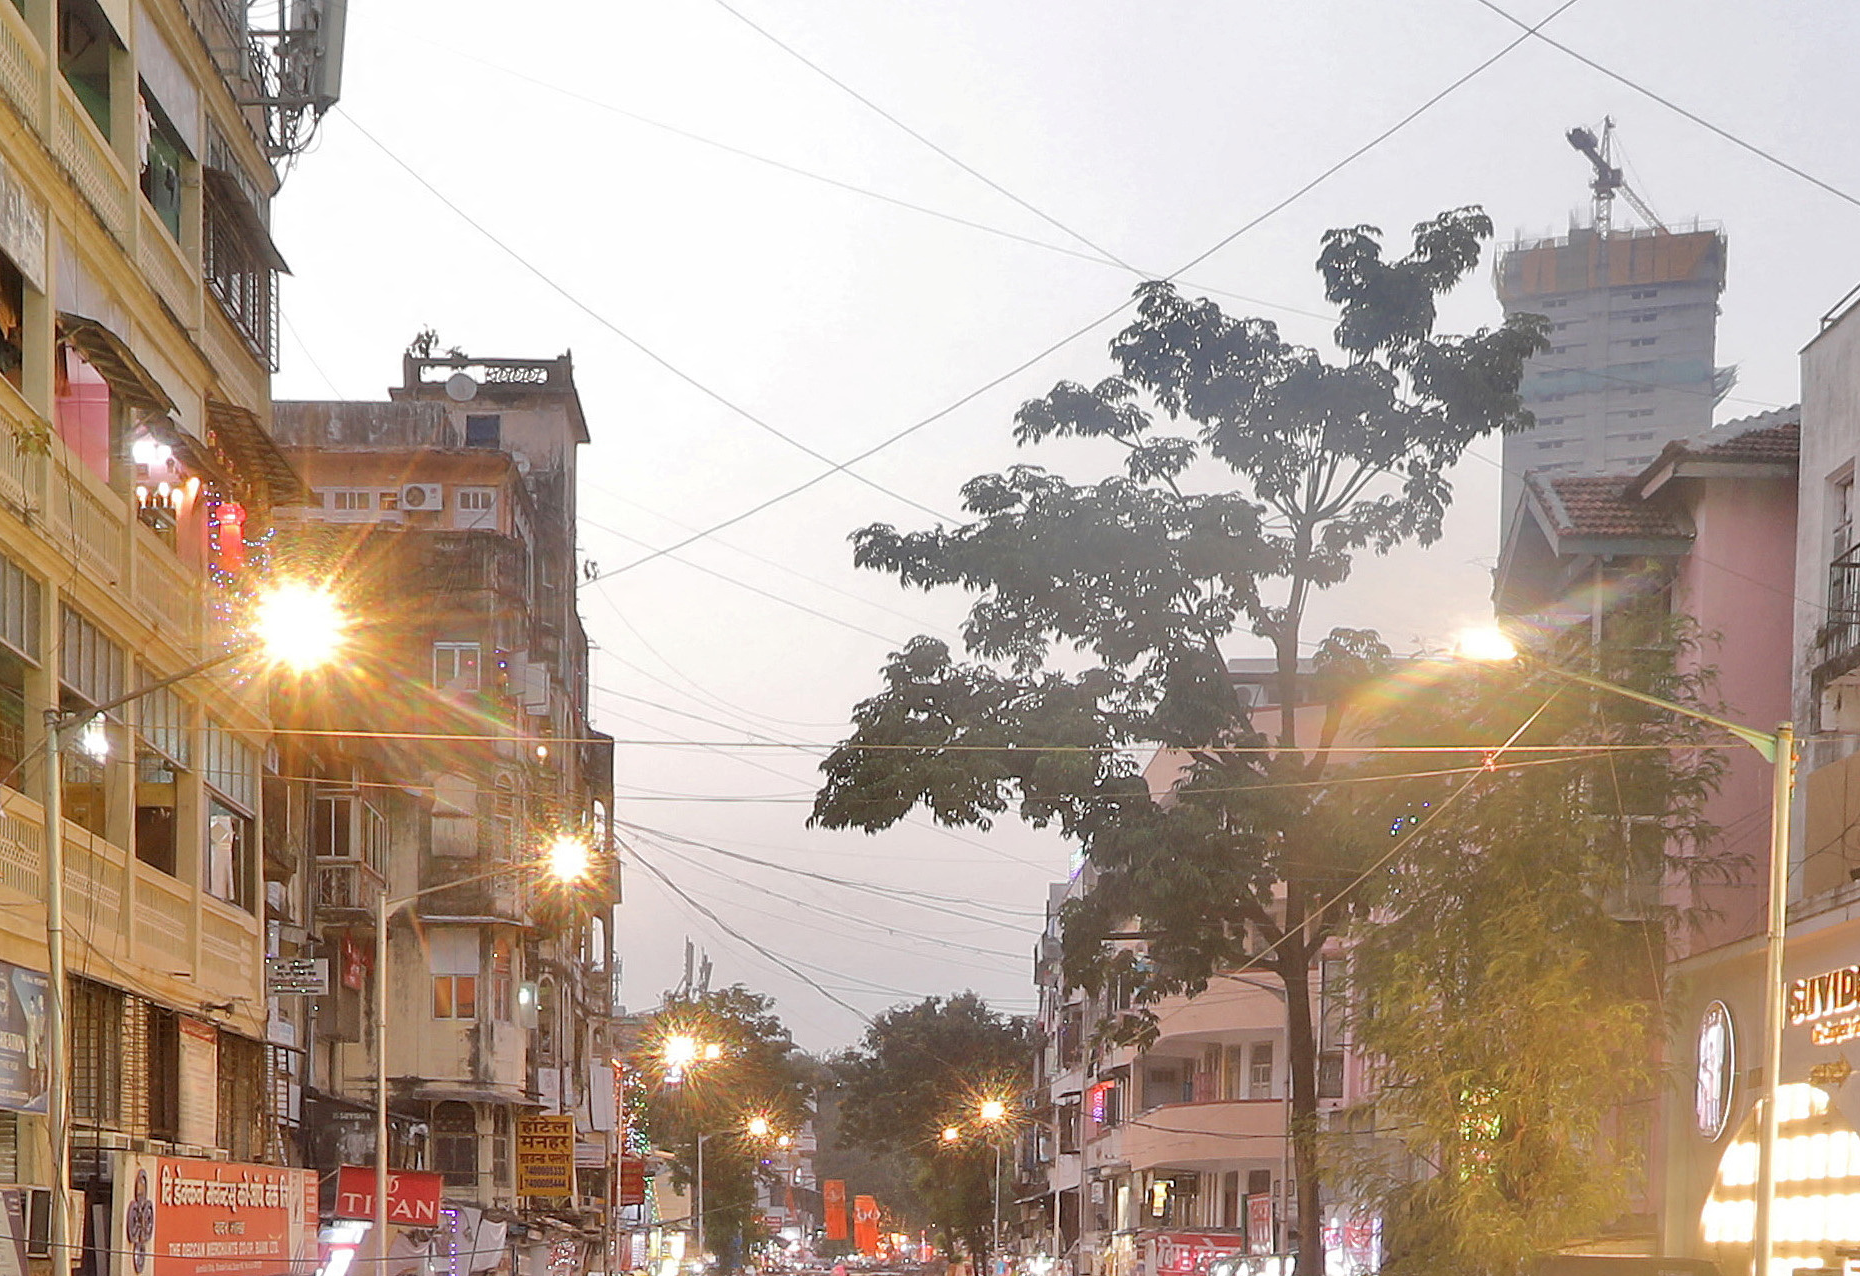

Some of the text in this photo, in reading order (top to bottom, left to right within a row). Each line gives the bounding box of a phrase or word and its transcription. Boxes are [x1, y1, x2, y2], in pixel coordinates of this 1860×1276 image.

[520, 1117, 569, 1134] हॉटेल
[520, 1136, 569, 1150] मनहर
[342, 1191, 435, 1220] TIAN
